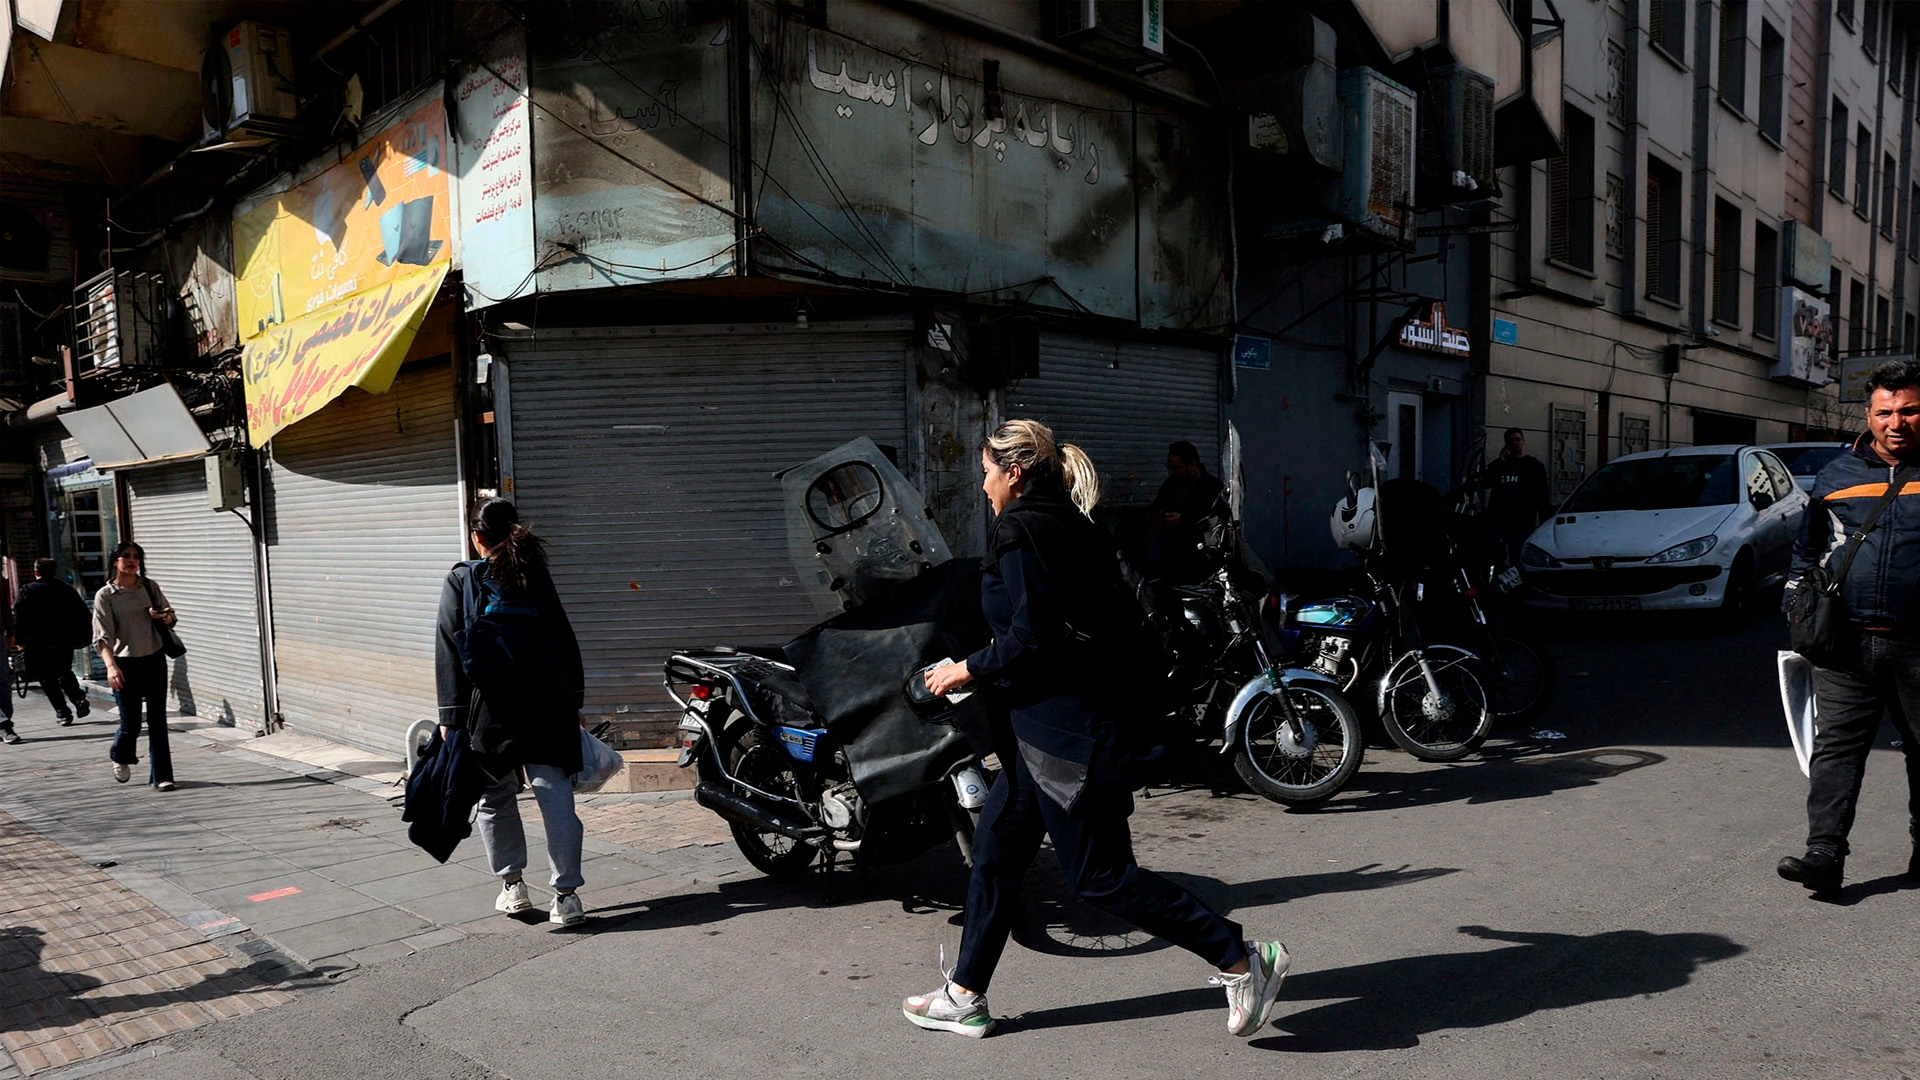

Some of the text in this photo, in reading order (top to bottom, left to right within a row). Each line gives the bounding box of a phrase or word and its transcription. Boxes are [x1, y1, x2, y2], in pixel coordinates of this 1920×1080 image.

[806, 27, 923, 119] آسیا
[589, 79, 683, 146] آسیا
[500, 142, 522, 162] خدمات
[1012, 98, 1100, 185] رایانه
[507, 165, 522, 189] فروش
[326, 237, 349, 281] کافی
[325, 273, 359, 301] تعمیرات
